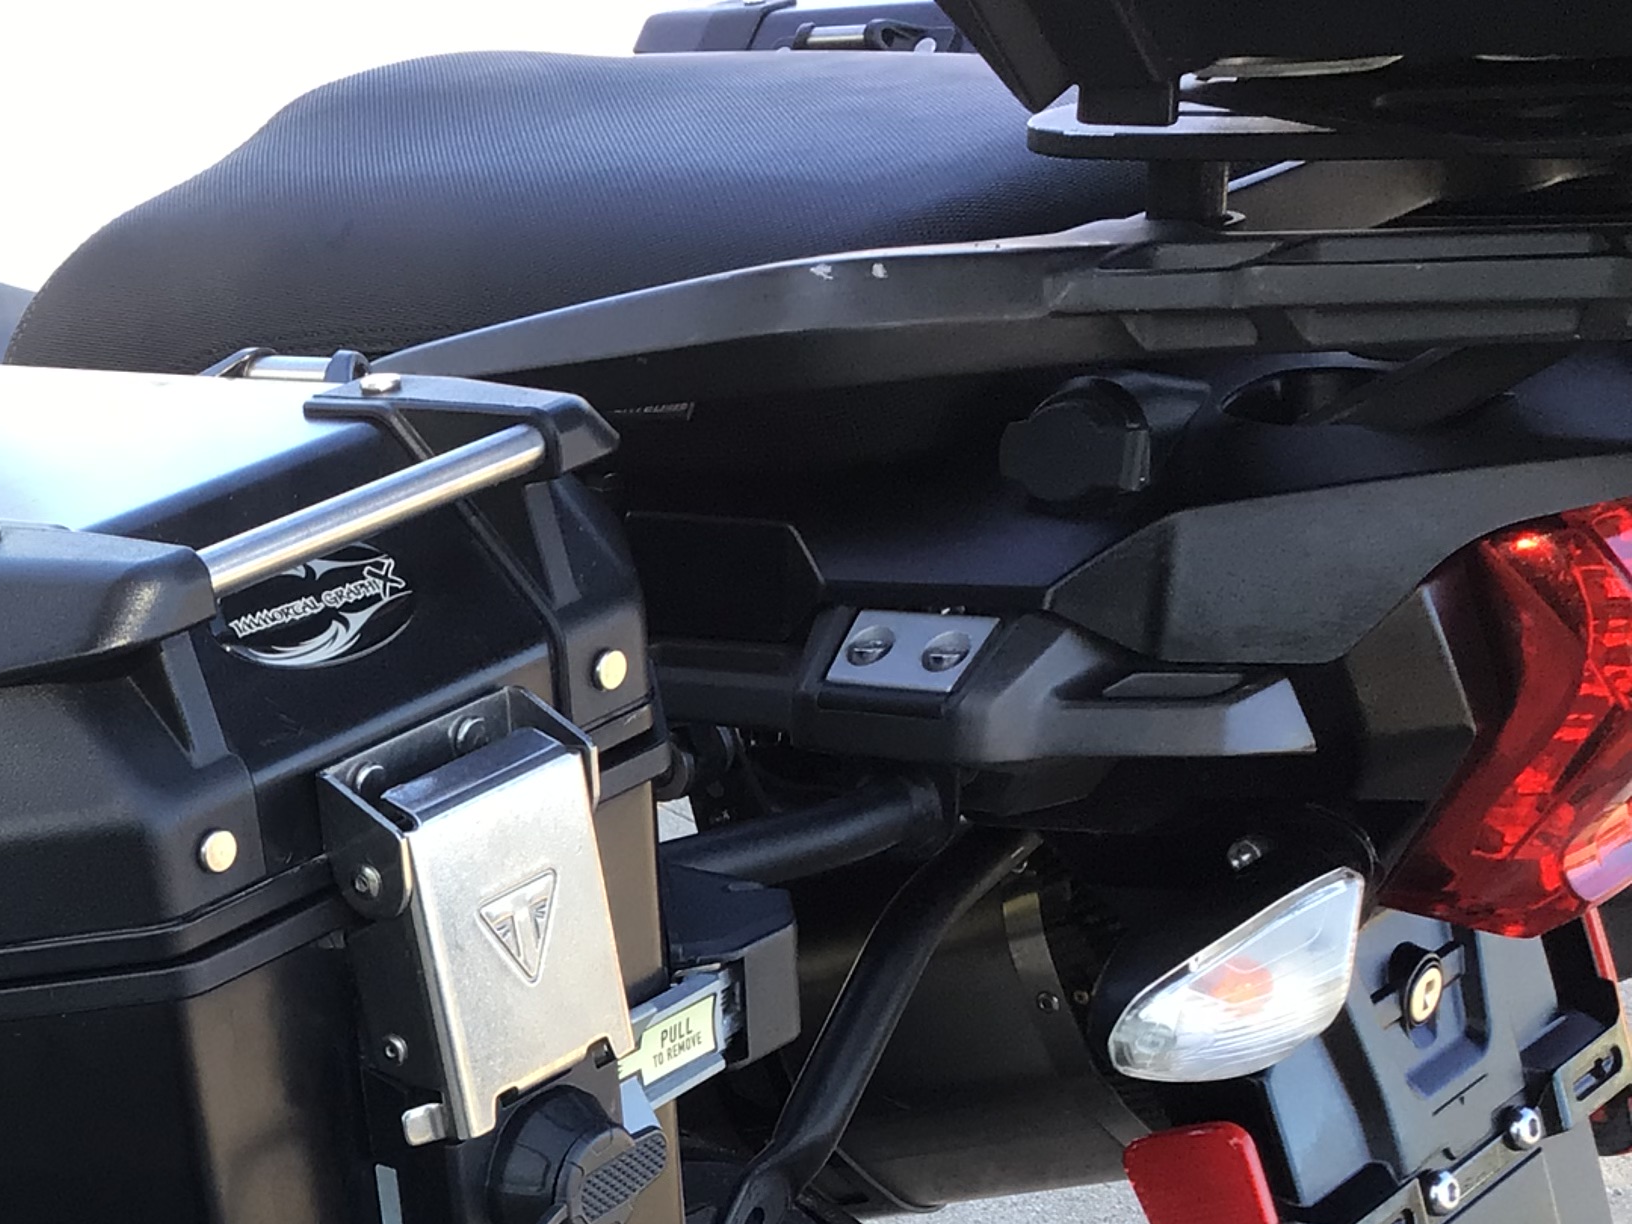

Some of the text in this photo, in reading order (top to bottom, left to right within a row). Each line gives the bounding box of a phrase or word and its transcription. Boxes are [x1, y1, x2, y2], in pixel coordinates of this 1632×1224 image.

[322, 558, 405, 608] GRAPHIX
[653, 1031, 702, 1067] TO REMOVE
[661, 1017, 693, 1048] PULL
